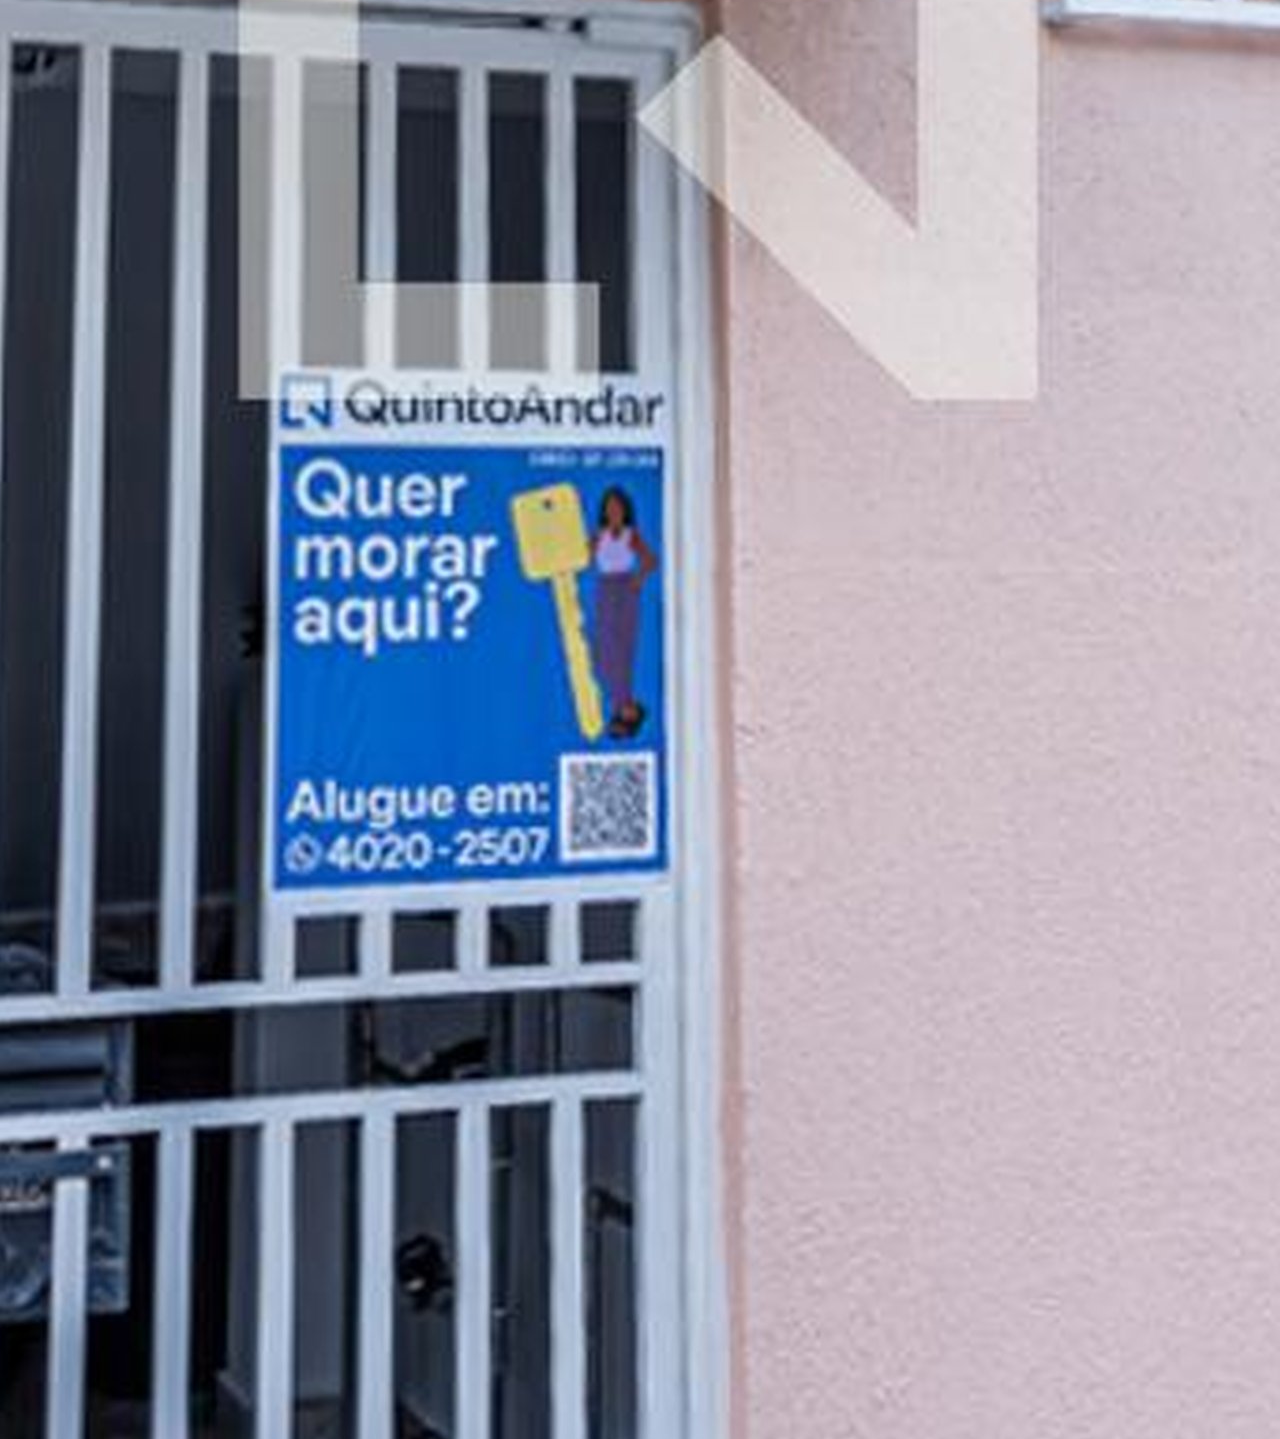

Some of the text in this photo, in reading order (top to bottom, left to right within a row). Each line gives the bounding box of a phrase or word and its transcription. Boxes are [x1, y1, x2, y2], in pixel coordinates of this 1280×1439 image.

[345, 378, 664, 430] QuintoAndar
[294, 459, 468, 520] Quer
[293, 532, 498, 582] morar
[293, 582, 481, 657] aqui?
[287, 779, 551, 829] Alugue em:
[326, 826, 551, 872] 4020-2507
